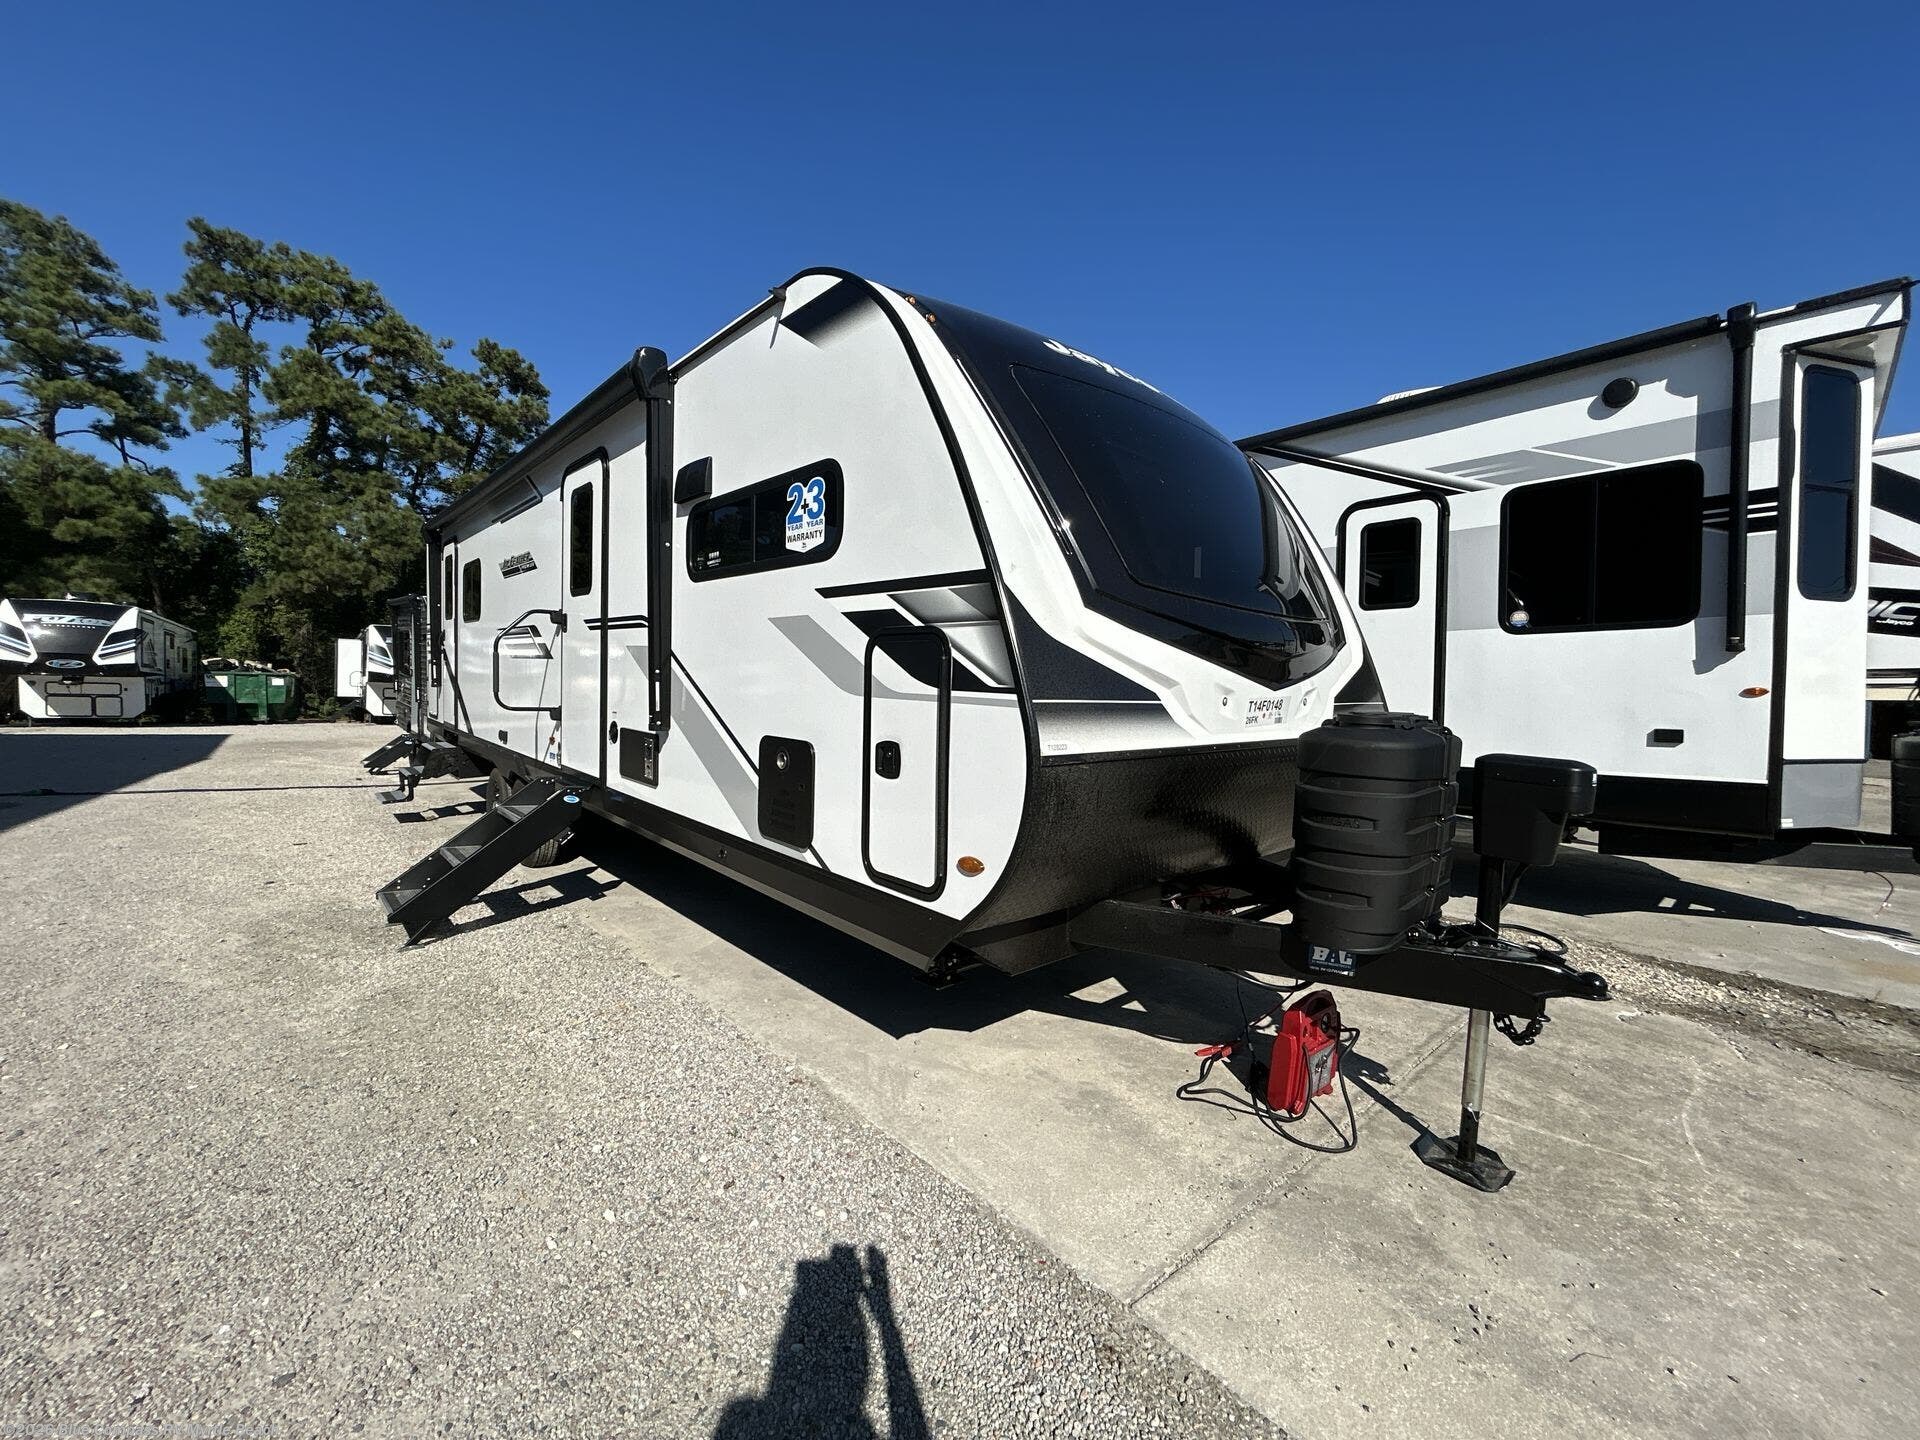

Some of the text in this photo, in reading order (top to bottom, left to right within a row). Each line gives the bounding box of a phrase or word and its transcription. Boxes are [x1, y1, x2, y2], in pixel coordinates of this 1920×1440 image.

[1043, 339, 1160, 392] Jay
[788, 518, 824, 532] YEAR YEAR
[787, 529, 823, 544] WARRANTY
[1867, 599, 1920, 620] IC
[1248, 699, 1284, 713] T14F0148
